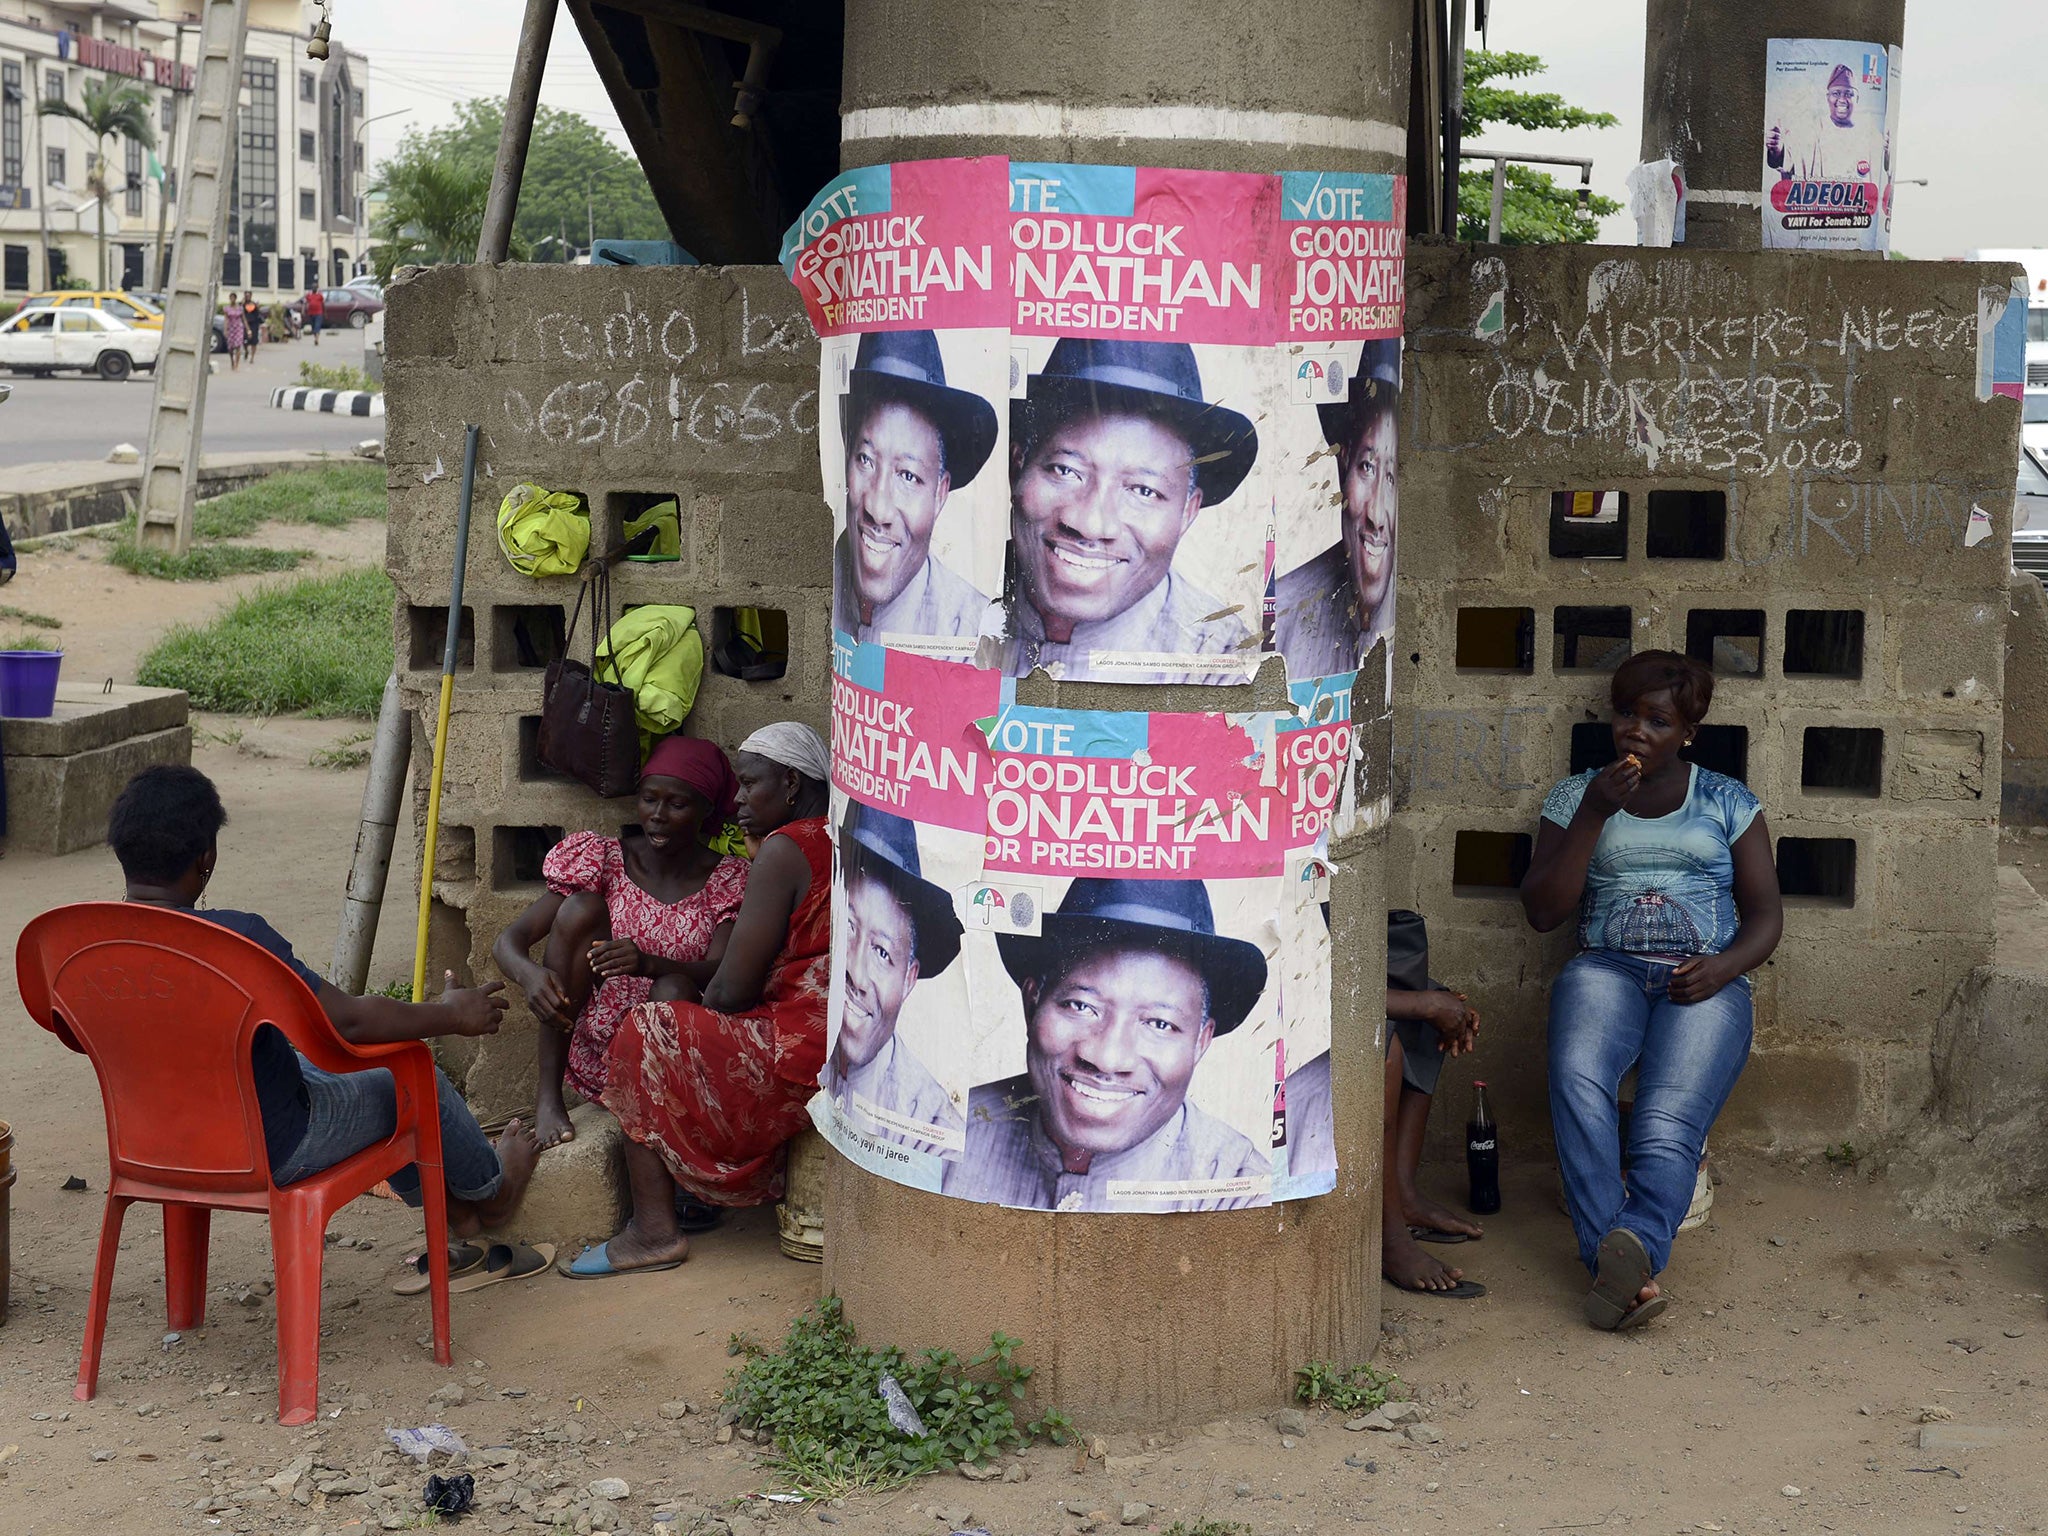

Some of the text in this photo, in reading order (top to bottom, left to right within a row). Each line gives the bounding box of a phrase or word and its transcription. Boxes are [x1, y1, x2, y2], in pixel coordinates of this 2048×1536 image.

[1009, 218, 1186, 256] ODLUCK
[1787, 215, 1869, 227] YAYI For Senate 2015
[798, 215, 927, 278] GOODLUCK
[1289, 226, 1404, 258] GOODLUCK
[809, 245, 993, 305] JONATHAN
[1009, 252, 1262, 309] NATHAN
[845, 295, 928, 325] PRESIDENT
[1017, 300, 1184, 332] PRESIDENT
[1289, 304, 1401, 332] FOR PRESIDENT
[1552, 307, 1807, 372] WORKERS
[837, 758, 911, 808] PRESIDENT
[1031, 840, 1197, 870] PRESIDENT
[860, 1137, 875, 1152] yayi
[876, 1145, 885, 1155] ni
[885, 1146, 910, 1163] jaree
